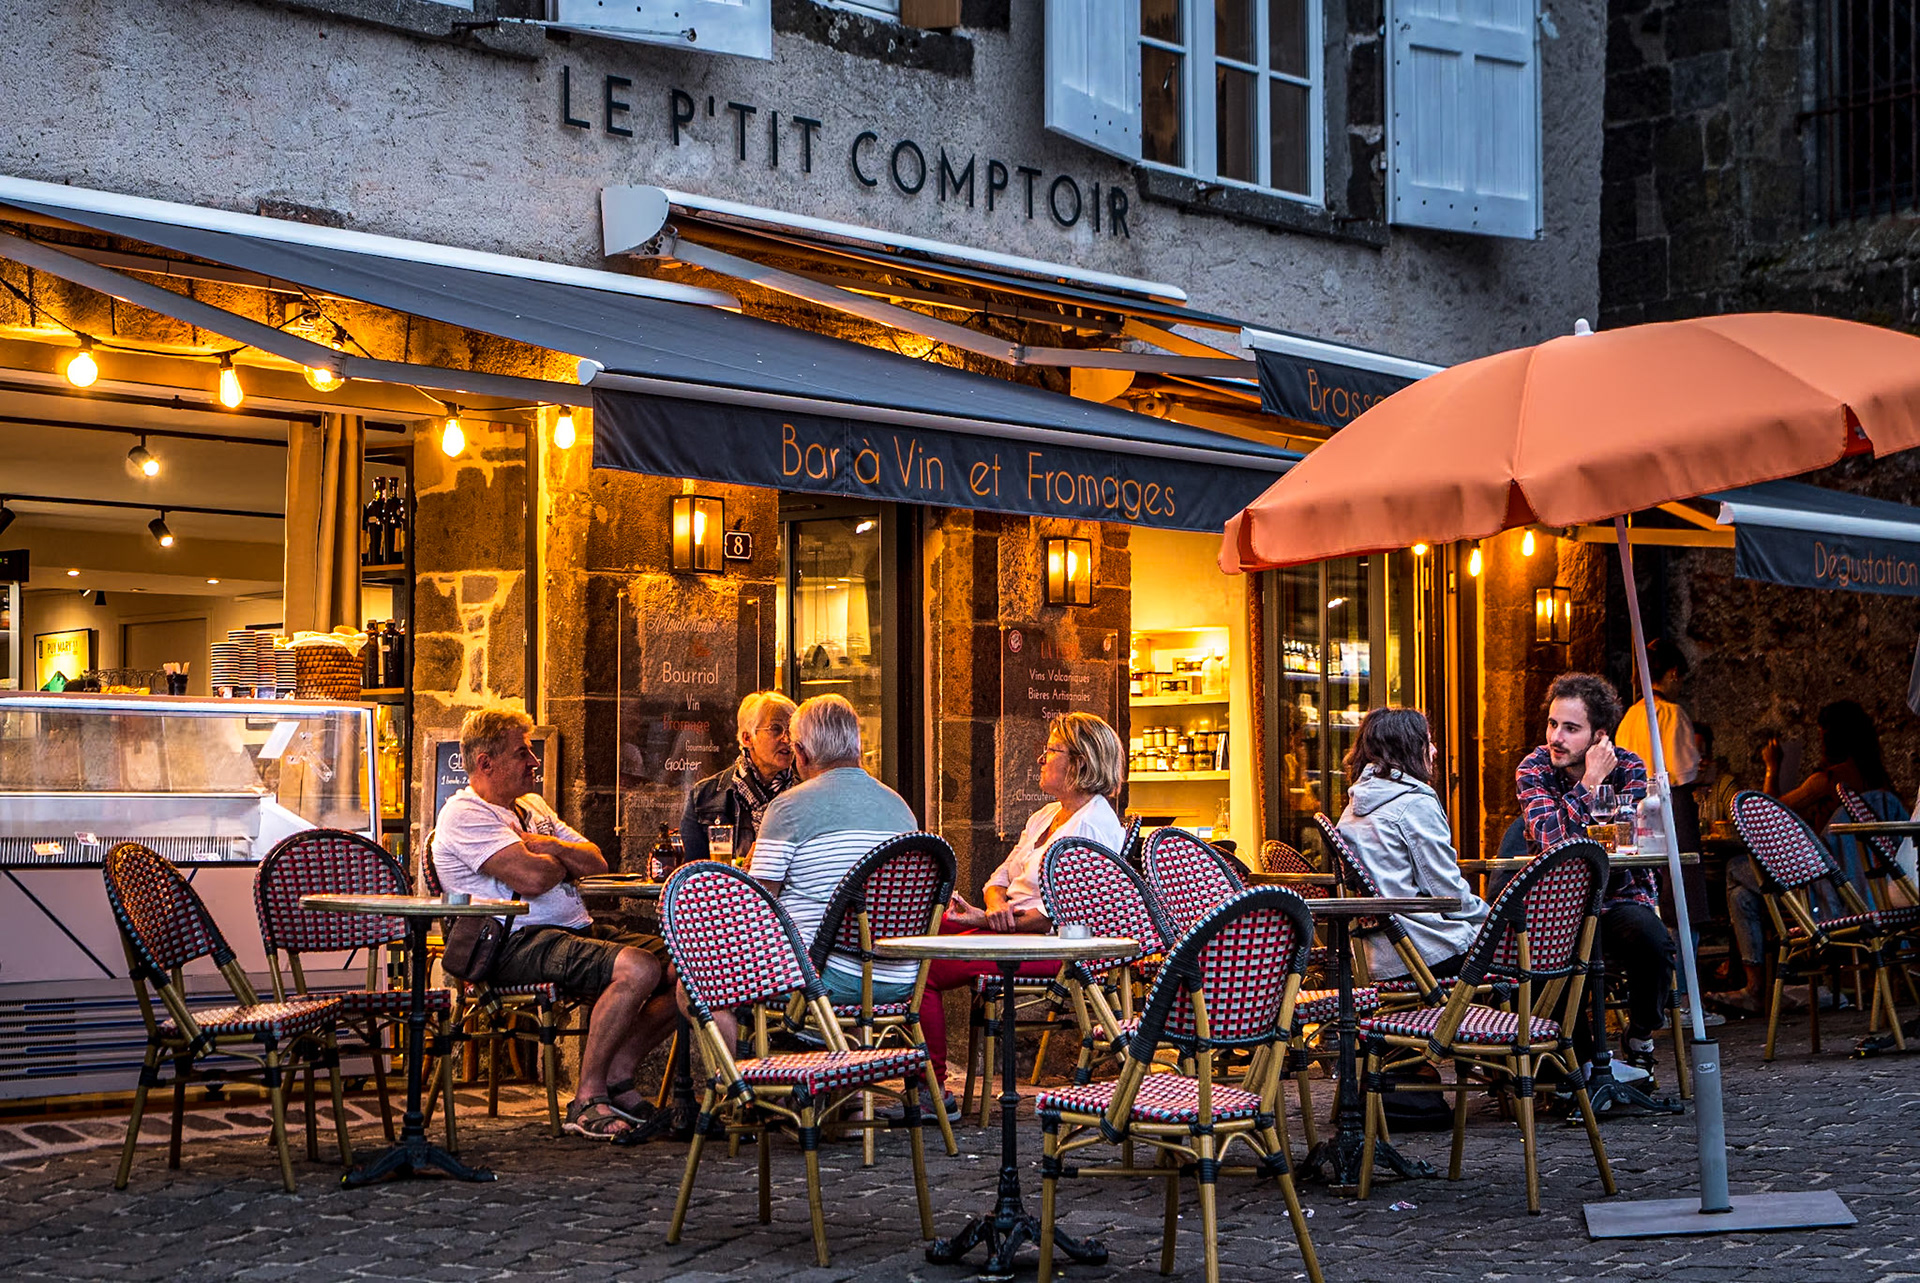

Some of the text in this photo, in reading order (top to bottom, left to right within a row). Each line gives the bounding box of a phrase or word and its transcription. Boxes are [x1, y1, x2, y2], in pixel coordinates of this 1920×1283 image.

[563, 65, 1131, 239] LE P'TIT COMPTOIR
[782, 423, 1176, 521] Bar à Vin et Fromages
[733, 535, 744, 556] 8
[1814, 541, 1919, 588] Dégustation
[662, 661, 719, 685] Bourriol
[1029, 668, 1090, 684] Vins Volcaniques
[686, 693, 700, 711] Vin
[1028, 687, 1091, 702] Bières Artisanales
[663, 713, 710, 733] Fromage
